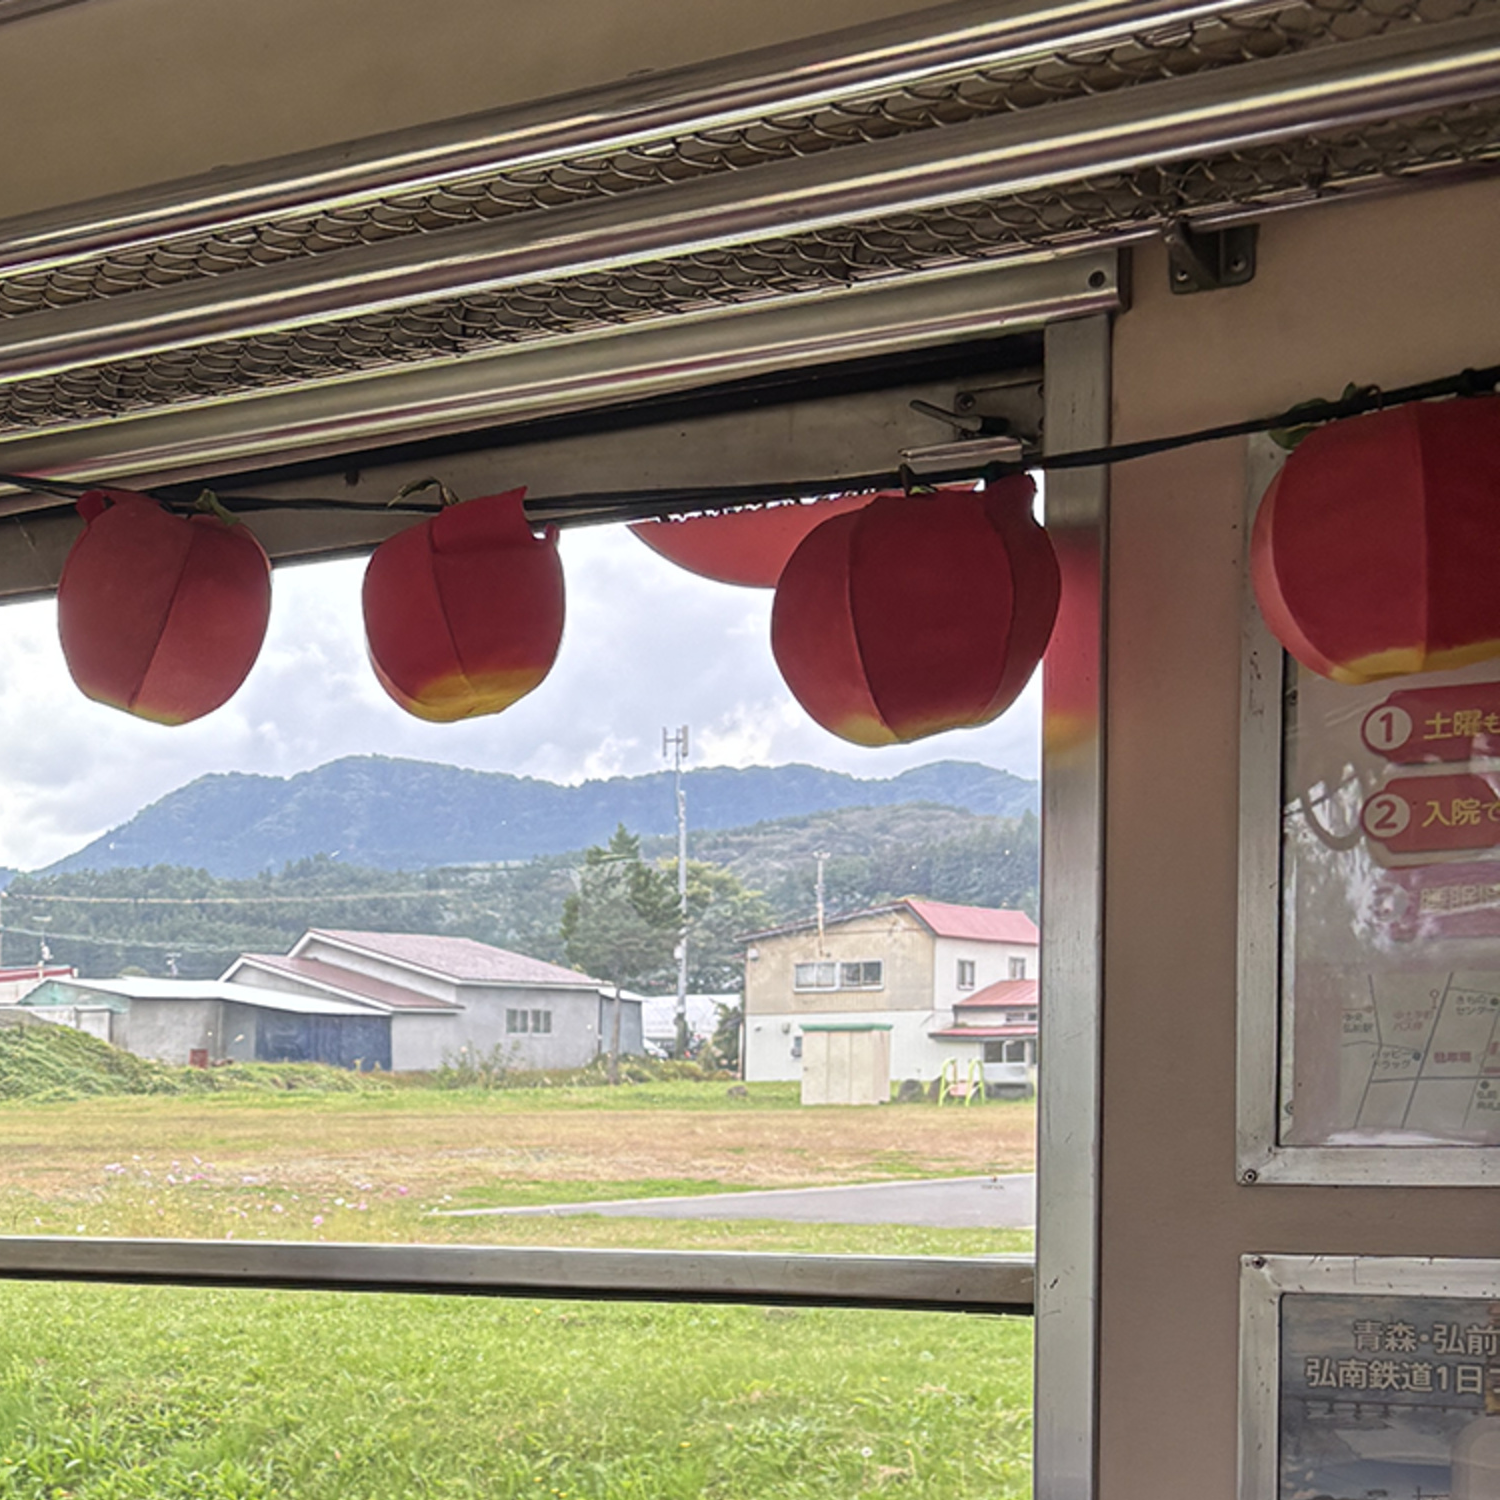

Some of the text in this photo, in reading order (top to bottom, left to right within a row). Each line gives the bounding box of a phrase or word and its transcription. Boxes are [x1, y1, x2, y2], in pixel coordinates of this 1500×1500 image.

[1380, 711, 1393, 743] 1
[1374, 799, 1398, 830] 2
[1354, 1321, 1500, 1355] 青森・弘前
